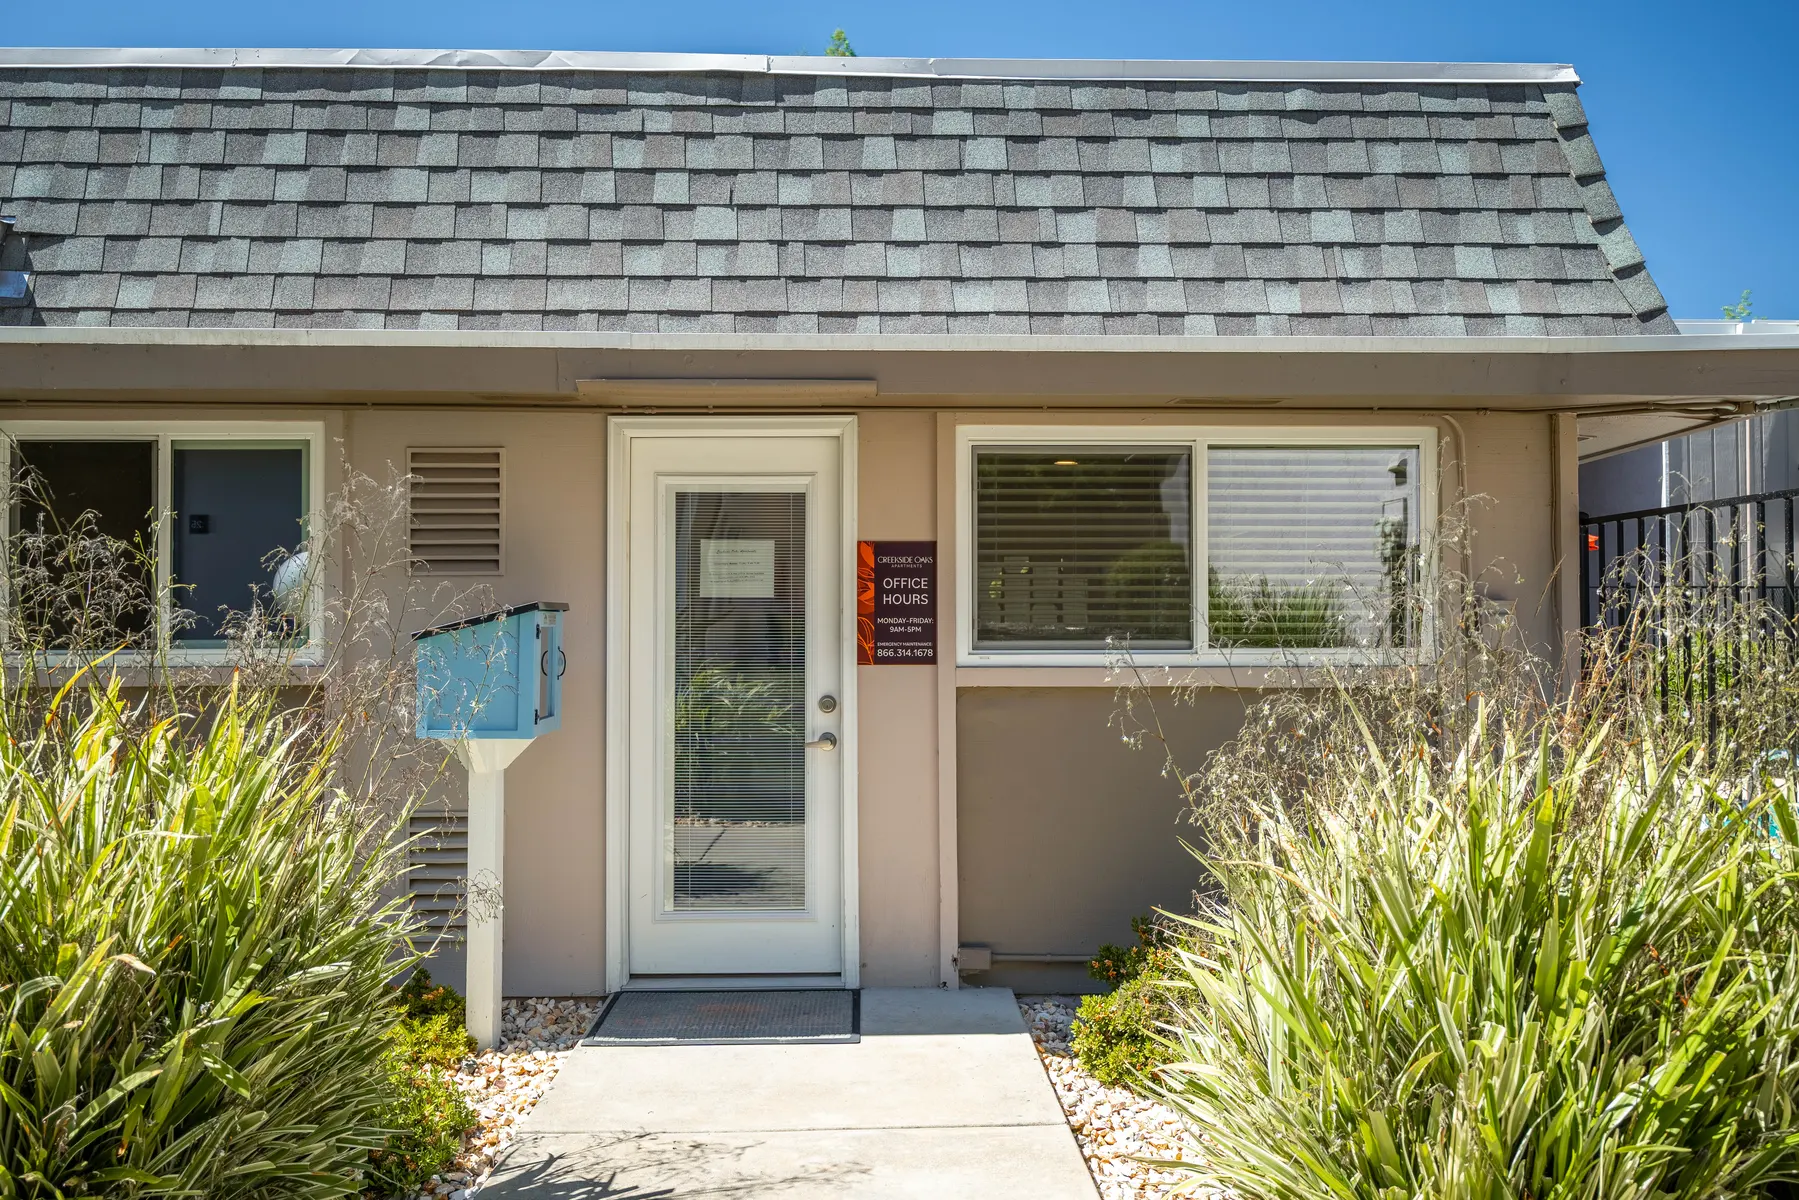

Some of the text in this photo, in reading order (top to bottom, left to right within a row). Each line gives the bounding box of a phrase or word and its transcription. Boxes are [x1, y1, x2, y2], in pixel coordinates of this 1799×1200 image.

[883, 577, 928, 589] OFFICE
[883, 593, 928, 605] HOURS
[877, 648, 933, 657] 866.314.1678
